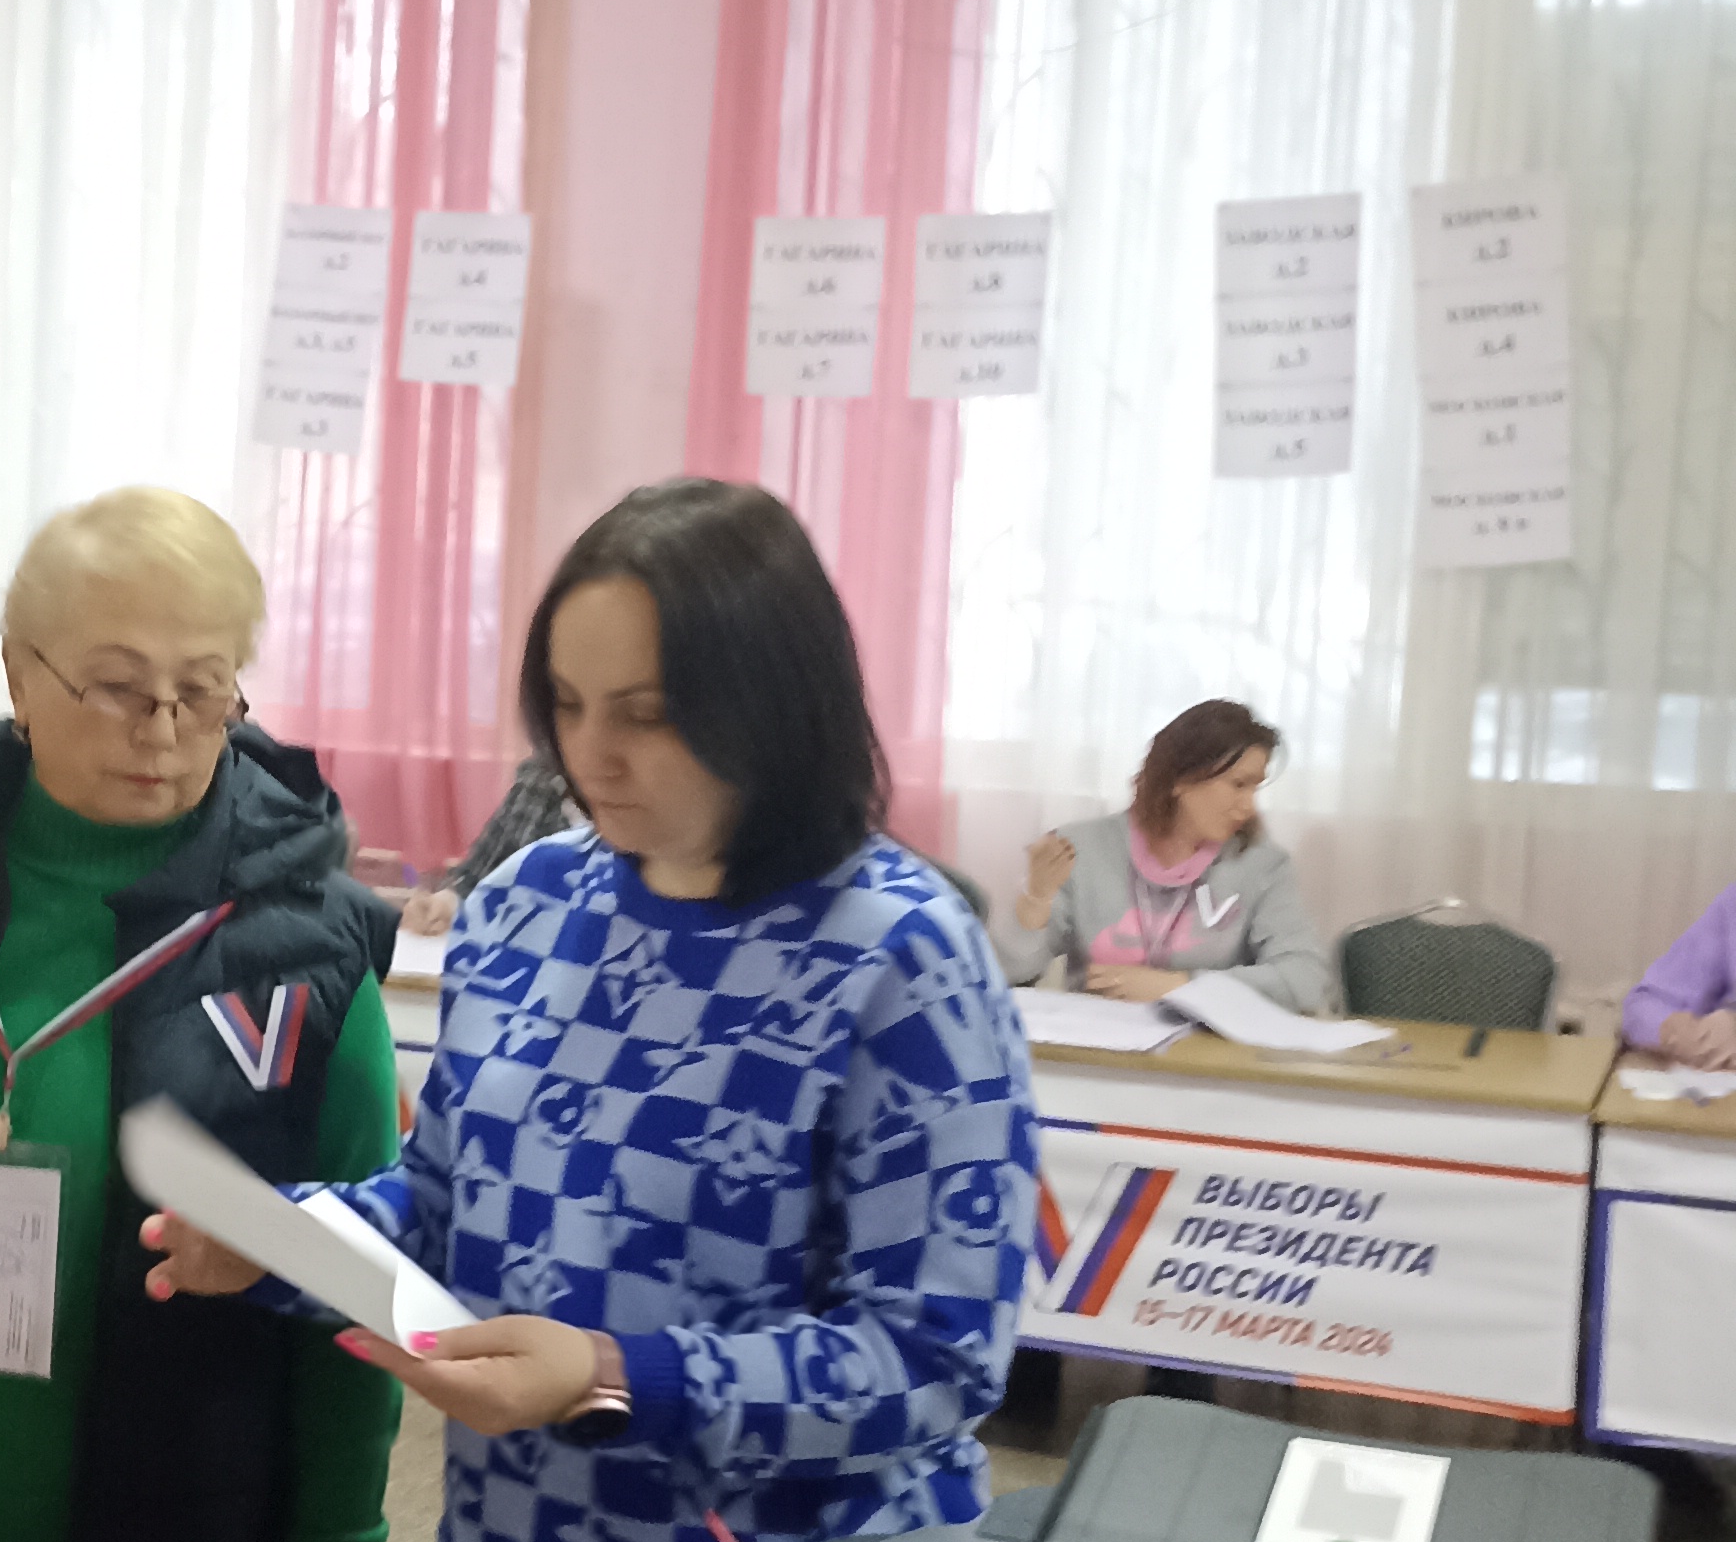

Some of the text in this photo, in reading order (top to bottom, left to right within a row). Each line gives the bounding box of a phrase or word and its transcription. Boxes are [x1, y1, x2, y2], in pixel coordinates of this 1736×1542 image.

[1194, 1174, 1386, 1223] ВЫБОРЫ
[1171, 1216, 1439, 1276] ПРЕЗИДЕНТА
[1147, 1258, 1320, 1308] РОССИИ
[1212, 1309, 1315, 1347] МАРТА
